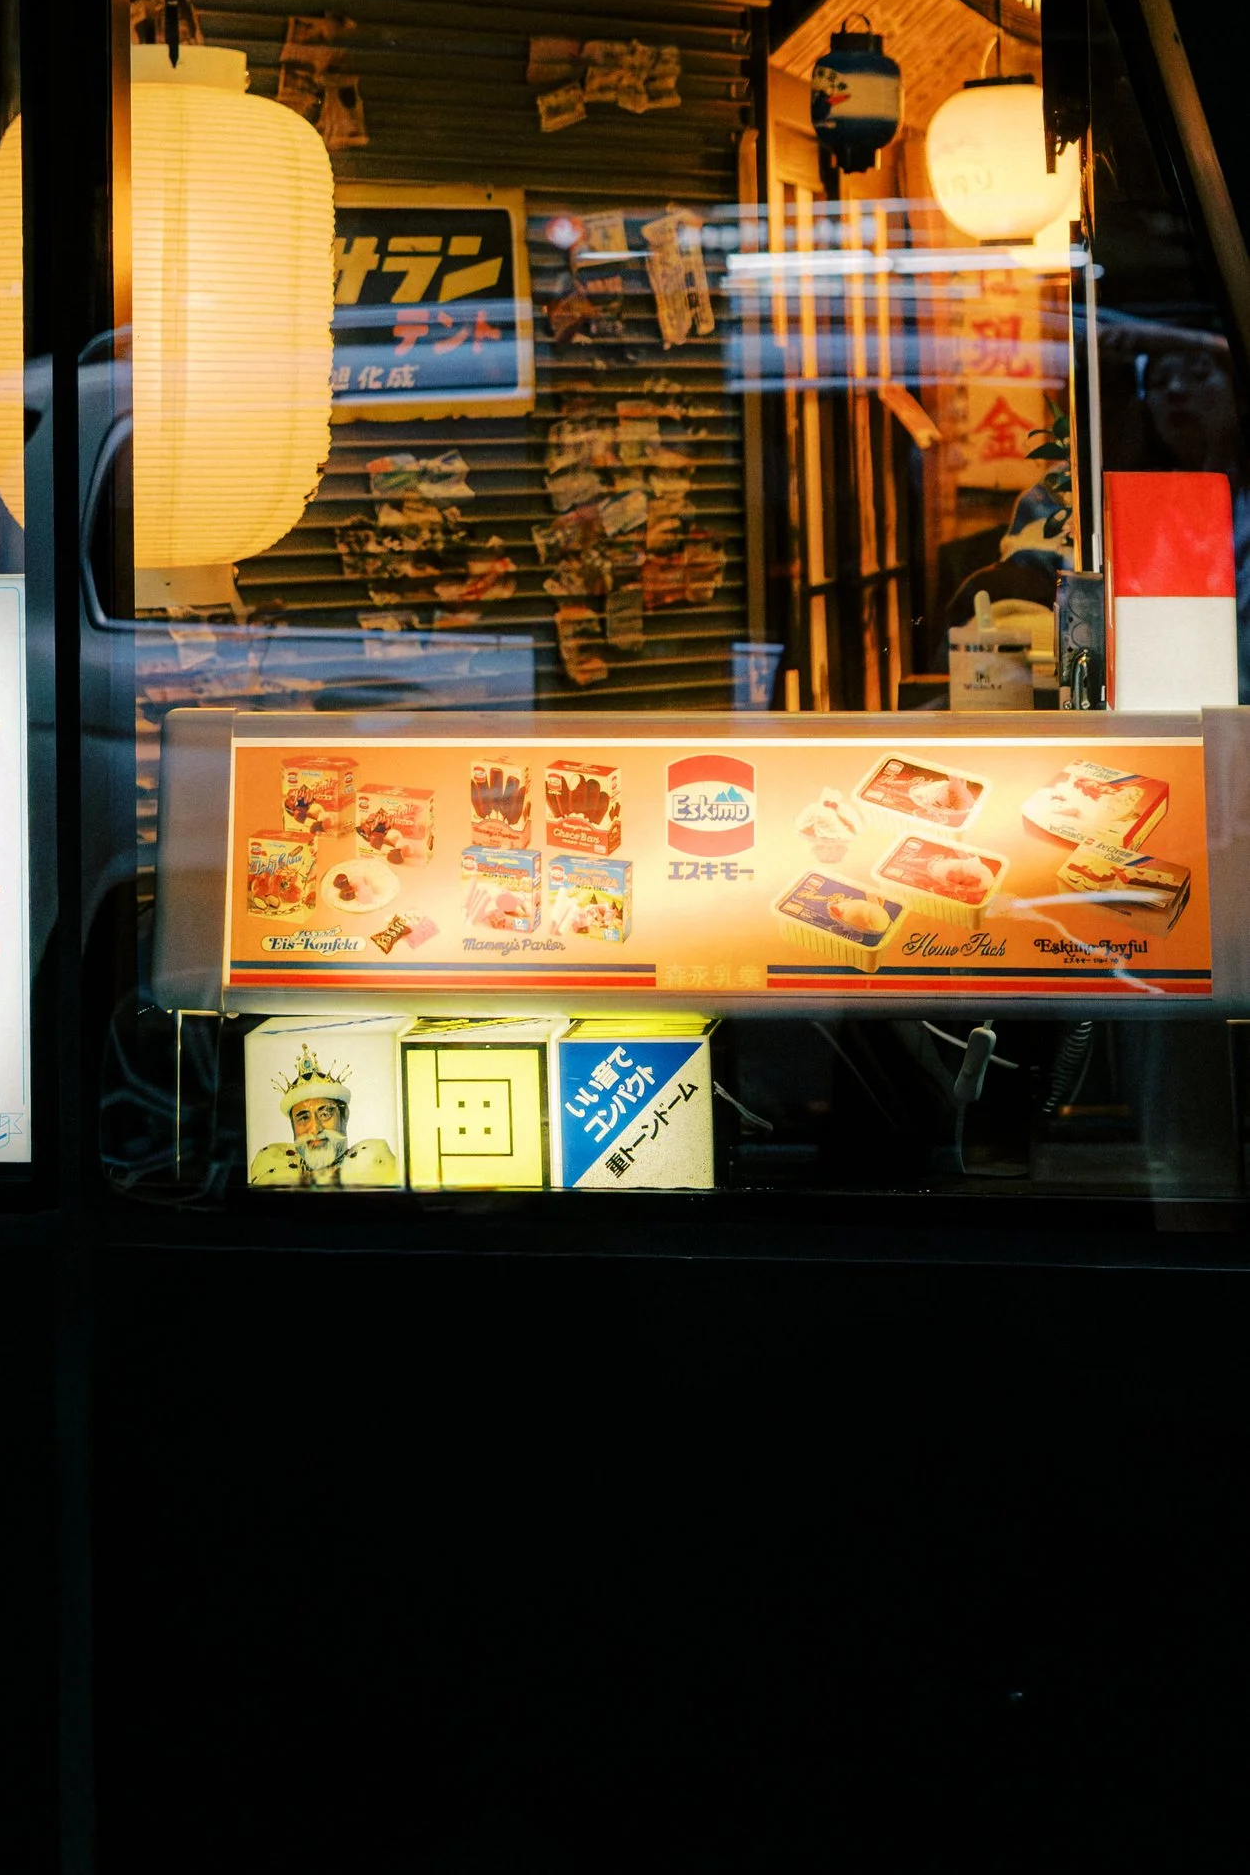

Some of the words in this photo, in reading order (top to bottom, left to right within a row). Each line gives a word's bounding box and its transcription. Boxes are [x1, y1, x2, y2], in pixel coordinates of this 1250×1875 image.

[334, 235, 504, 305] サラン
[392, 309, 501, 357] テント
[672, 794, 750, 823] Eskimo
[667, 860, 755, 882] エスキモー
[268, 936, 360, 956] Eis-Konfekt
[462, 937, 521, 957] Mammy's
[522, 937, 566, 952] Parlor
[901, 932, 960, 958] Home
[960, 931, 1008, 957] Pack
[663, 963, 762, 989] 森永乳業
[563, 1044, 635, 1119] いい音で
[582, 1065, 656, 1143] コンパクト
[603, 1079, 700, 1180] 重トーンドーム
